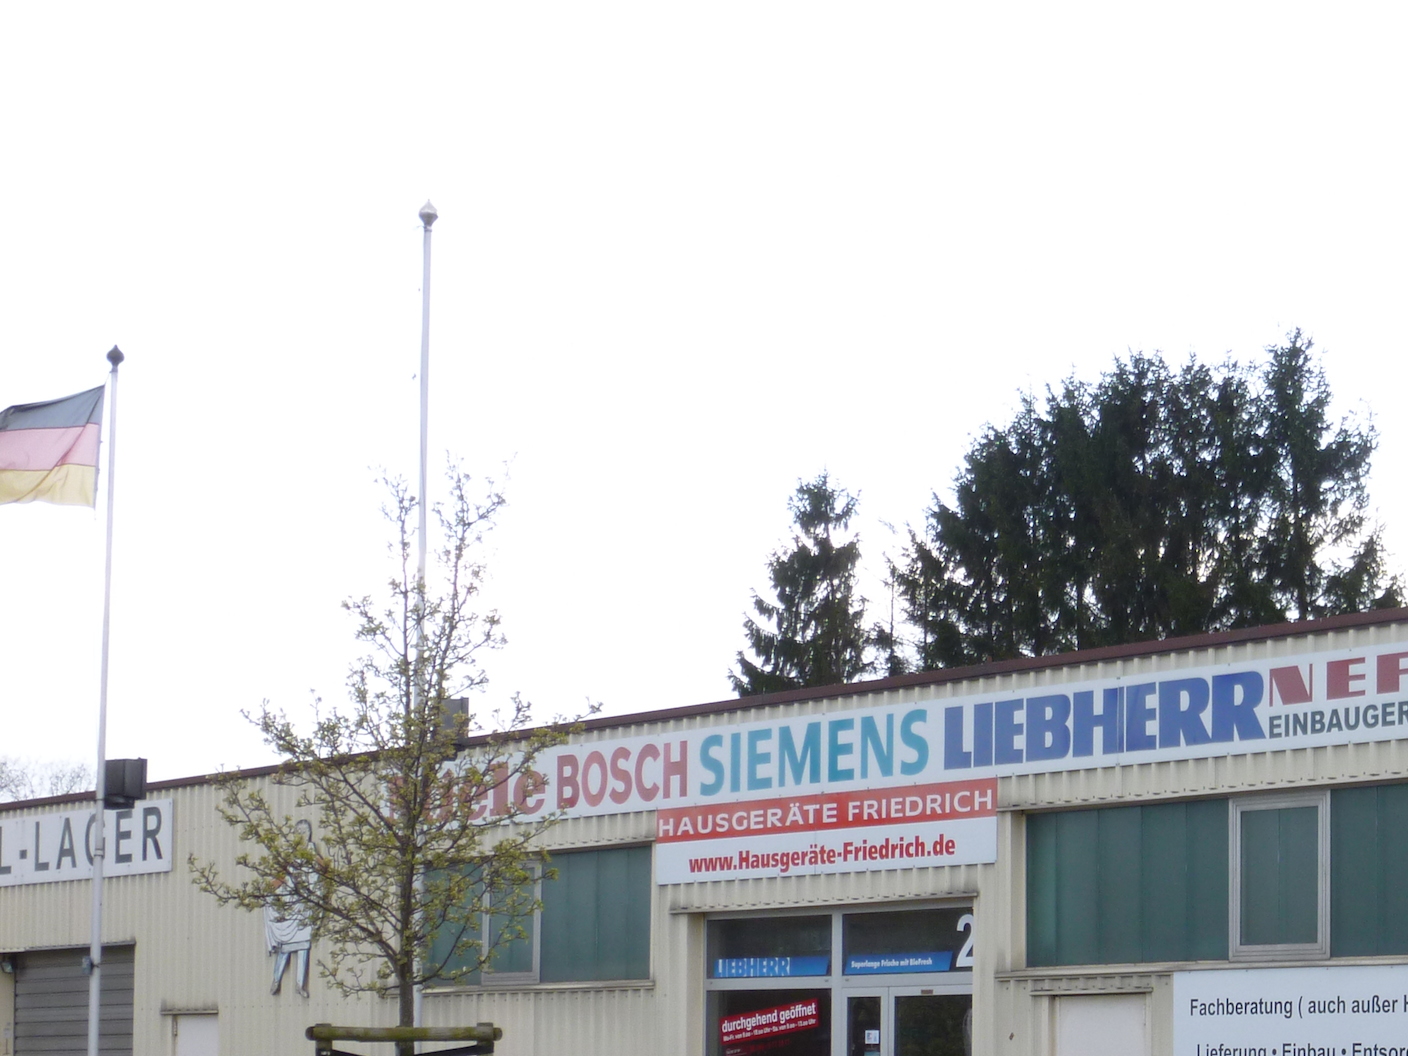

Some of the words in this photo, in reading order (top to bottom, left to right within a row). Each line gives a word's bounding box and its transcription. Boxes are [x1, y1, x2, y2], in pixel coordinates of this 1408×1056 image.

[944, 670, 1266, 770] LIEBHERR
[699, 708, 929, 797] SIEMENS
[556, 740, 688, 809] BOSCH
[659, 801, 838, 838] HAUSGERÄTE
[847, 788, 993, 822] FRIEDRICH
[689, 835, 956, 873] www.Hausgeräte-Friedrich.de
[715, 956, 791, 978] LIEBHERR
[850, 960, 880, 969] Superlange
[881, 959, 899, 968] Frische
[900, 957, 909, 967] mit
[722, 1009, 778, 1033] durchgehend
[779, 1002, 816, 1024] geöffnet
[1190, 997, 1293, 1018] Fachberatung
[1307, 996, 1346, 1014] auch
[1351, 995, 1398, 1014] außer
